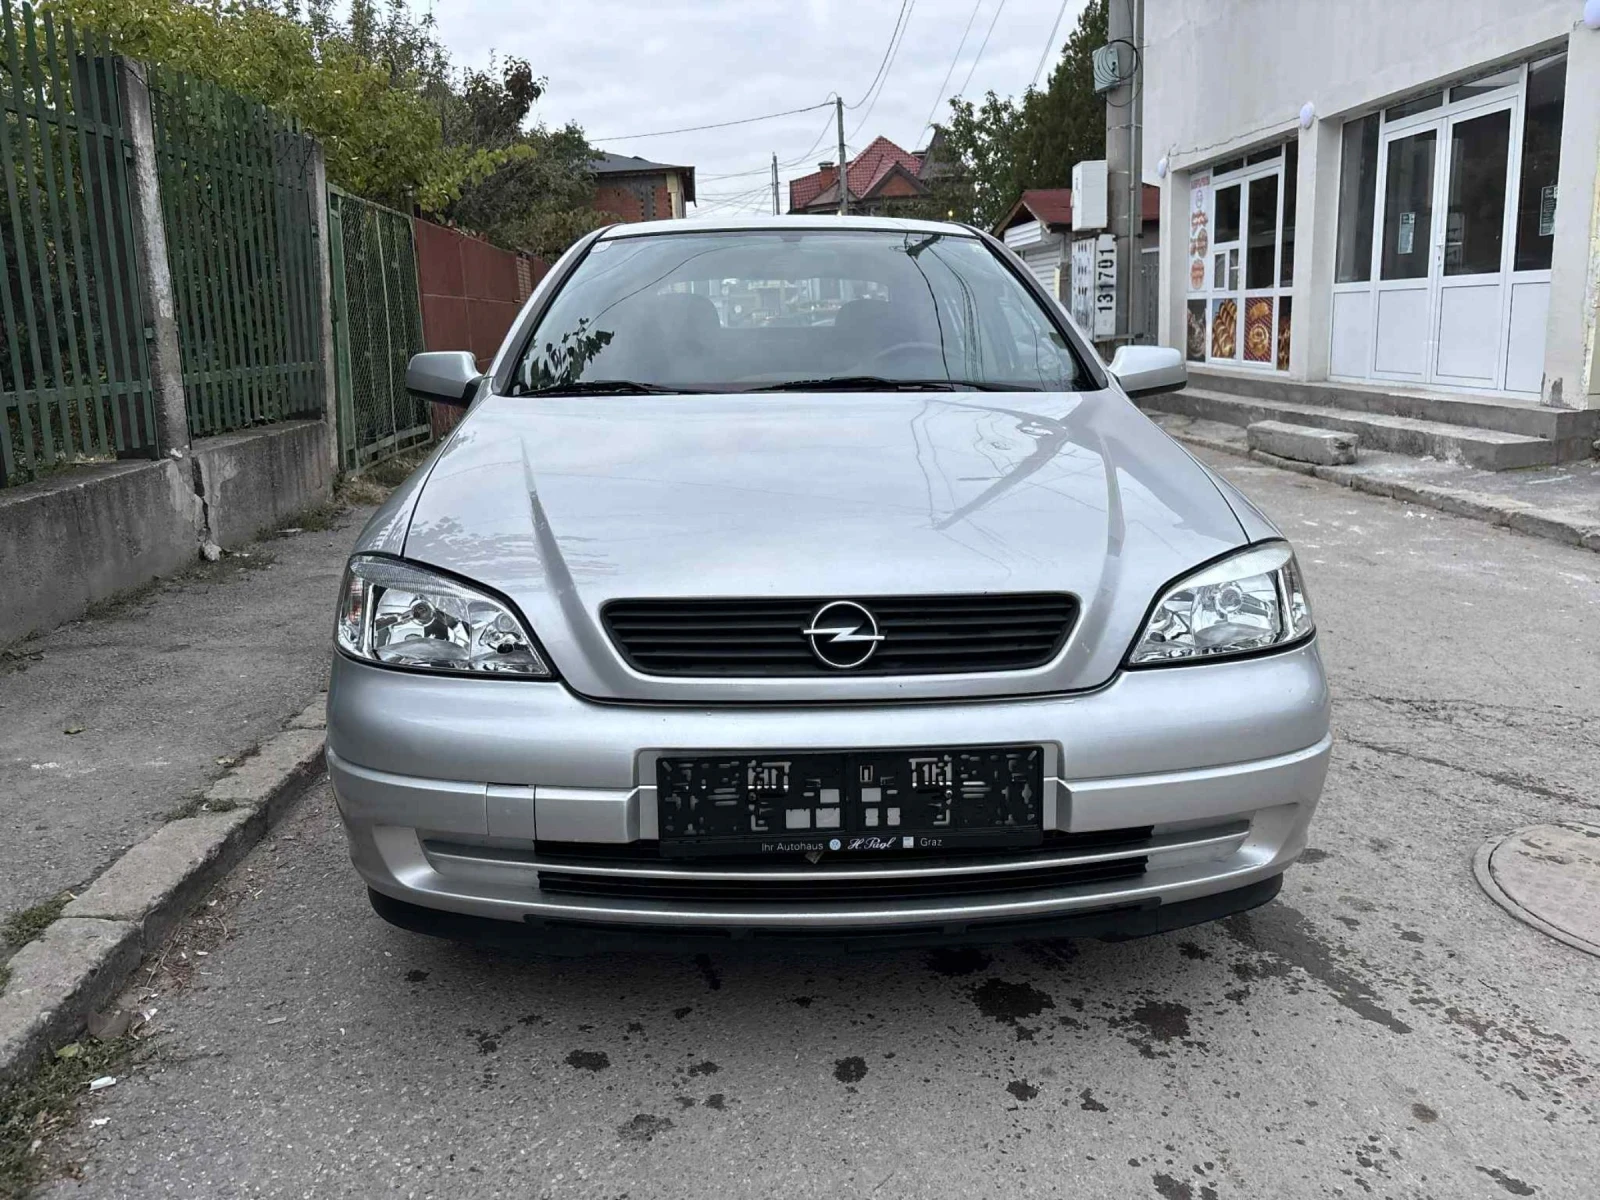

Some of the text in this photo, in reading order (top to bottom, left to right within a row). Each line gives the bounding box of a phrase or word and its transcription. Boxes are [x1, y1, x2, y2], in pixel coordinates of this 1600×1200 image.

[1098, 248, 1115, 314] 131701
[762, 842, 774, 852] Ihr
[777, 841, 824, 851] Autohaus
[920, 837, 943, 847] Graz
